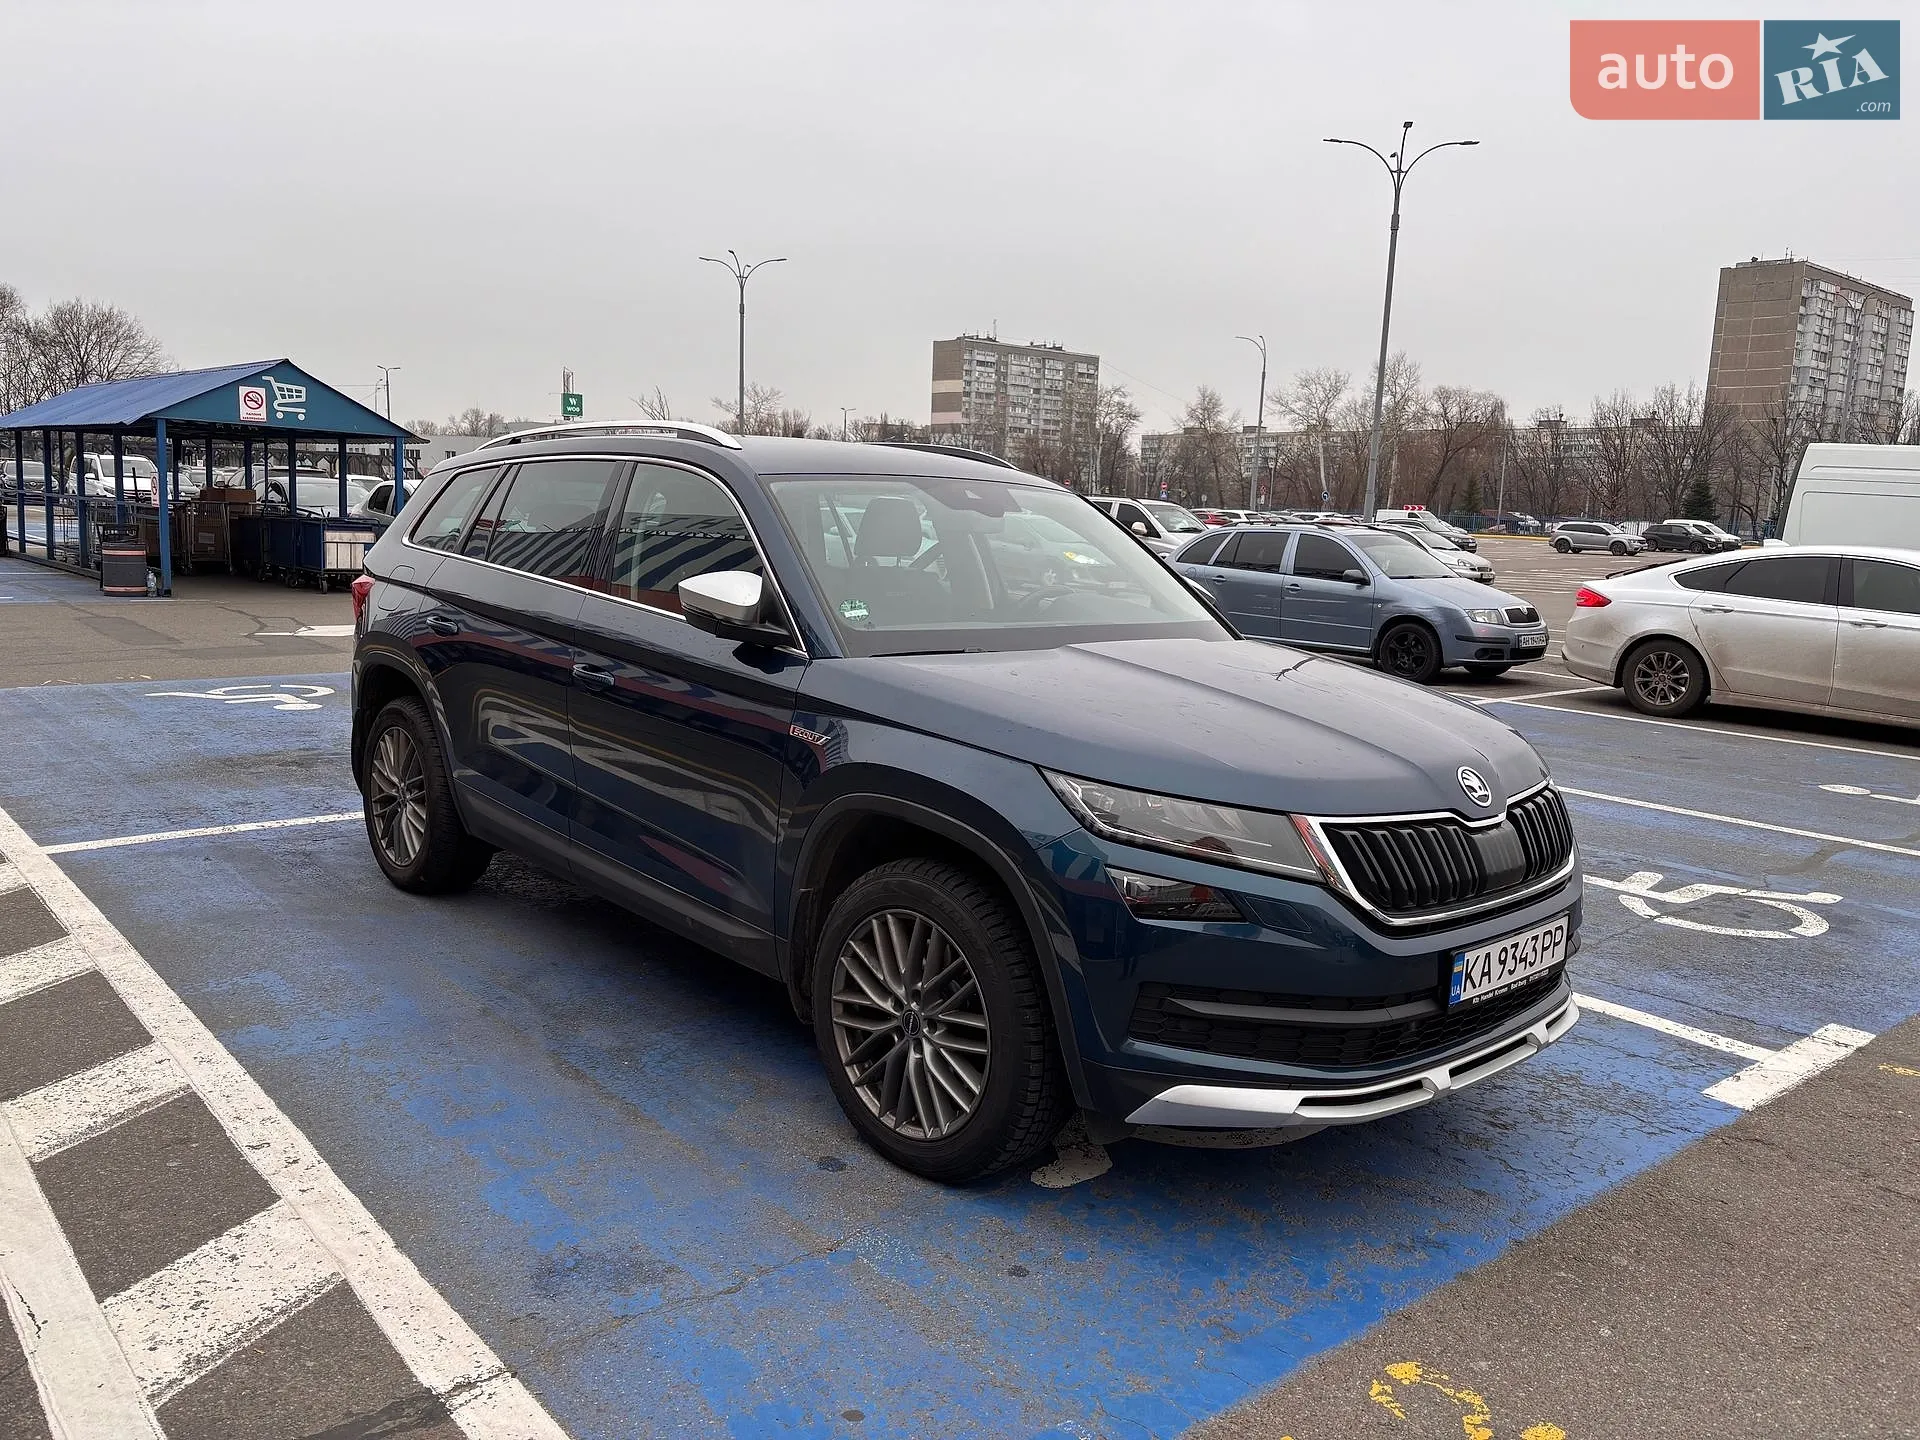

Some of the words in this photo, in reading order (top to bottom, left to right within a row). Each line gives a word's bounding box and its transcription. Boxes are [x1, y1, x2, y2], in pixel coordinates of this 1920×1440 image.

[794, 727, 821, 742] SCOUT
[1463, 952, 1492, 993] KA
[1451, 985, 1461, 997] UA
